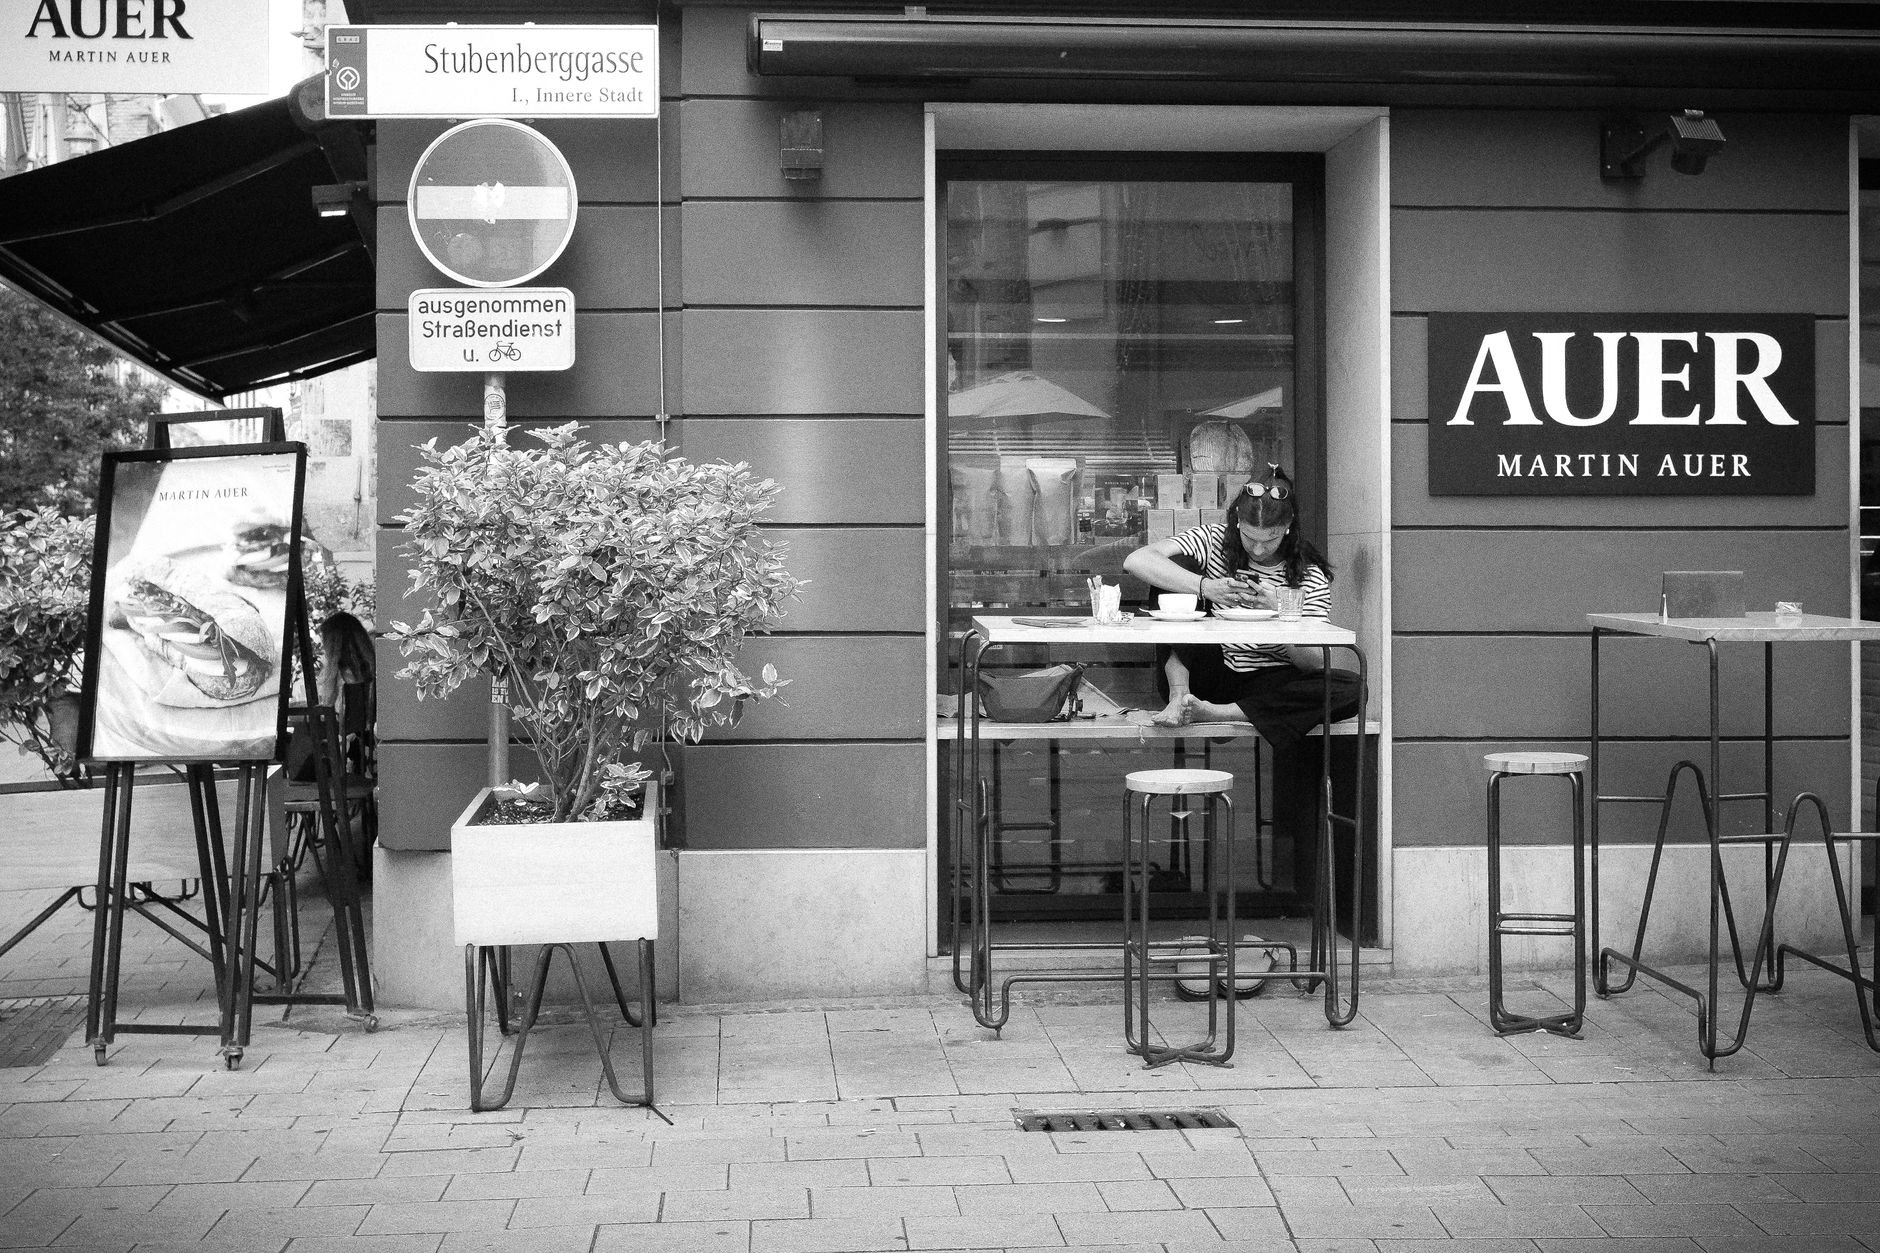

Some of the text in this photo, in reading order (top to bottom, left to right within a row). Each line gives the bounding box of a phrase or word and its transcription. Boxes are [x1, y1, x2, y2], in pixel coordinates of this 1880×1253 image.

[24, 0, 194, 39] AUER
[49, 50, 171, 63] MARTIN AUER
[424, 43, 644, 81] Stubenberggasse
[536, 87, 593, 103] Innere
[599, 87, 643, 103] Stadt
[418, 299, 566, 318] ausgenommen
[422, 319, 562, 338] Straßendienst
[463, 349, 479, 362] u.
[1446, 330, 1800, 427] AUER
[1496, 453, 1753, 478] MARTIN AUER
[159, 487, 248, 501] MARTIN AUER
